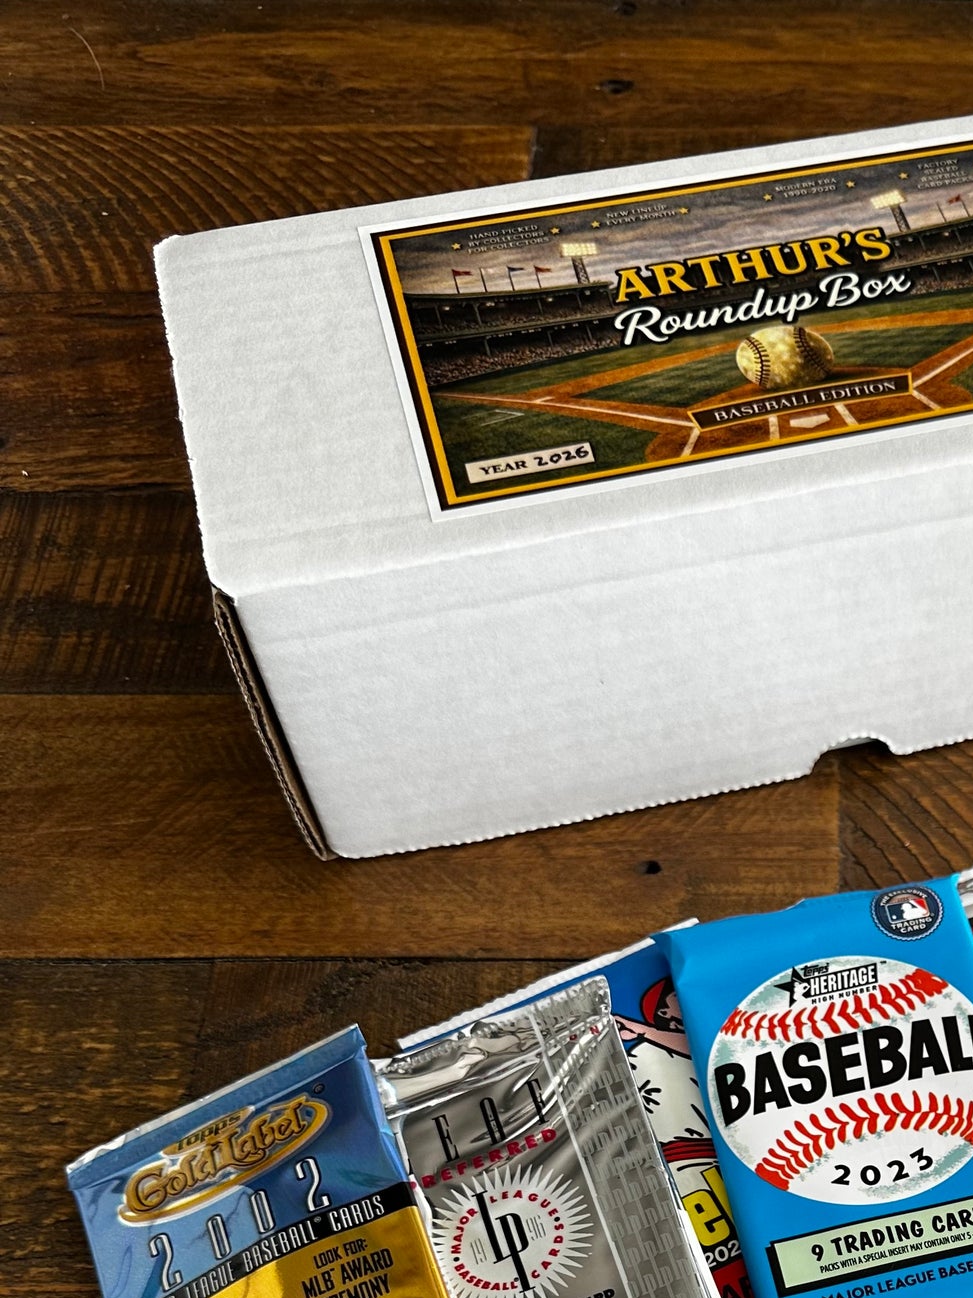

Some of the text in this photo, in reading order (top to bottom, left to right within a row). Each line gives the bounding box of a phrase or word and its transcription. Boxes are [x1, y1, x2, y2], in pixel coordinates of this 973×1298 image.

[470, 225, 538, 240] HAND PICKED
[607, 209, 677, 226] EVERY MONTH
[615, 229, 891, 303] ARTHUR'S
[614, 273, 911, 345] Roundup Box
[714, 381, 896, 423] BASEBALL EDITION
[479, 446, 589, 475] YEAR 2026
[810, 965, 878, 996] HERITAGE
[811, 985, 878, 1005] HIGH NUMBER
[831, 1149, 933, 1185] 2023
[243, 1224, 318, 1273] BASEBALL
[330, 1194, 385, 1233] CARDS
[811, 1244, 824, 1262] 9
[831, 1219, 924, 1257] TRADING
[340, 1248, 394, 1284] AWARD
[820, 1231, 966, 1274] PACKS WITH A SPECIAL INSERT MAY CONTAIN ONLY
